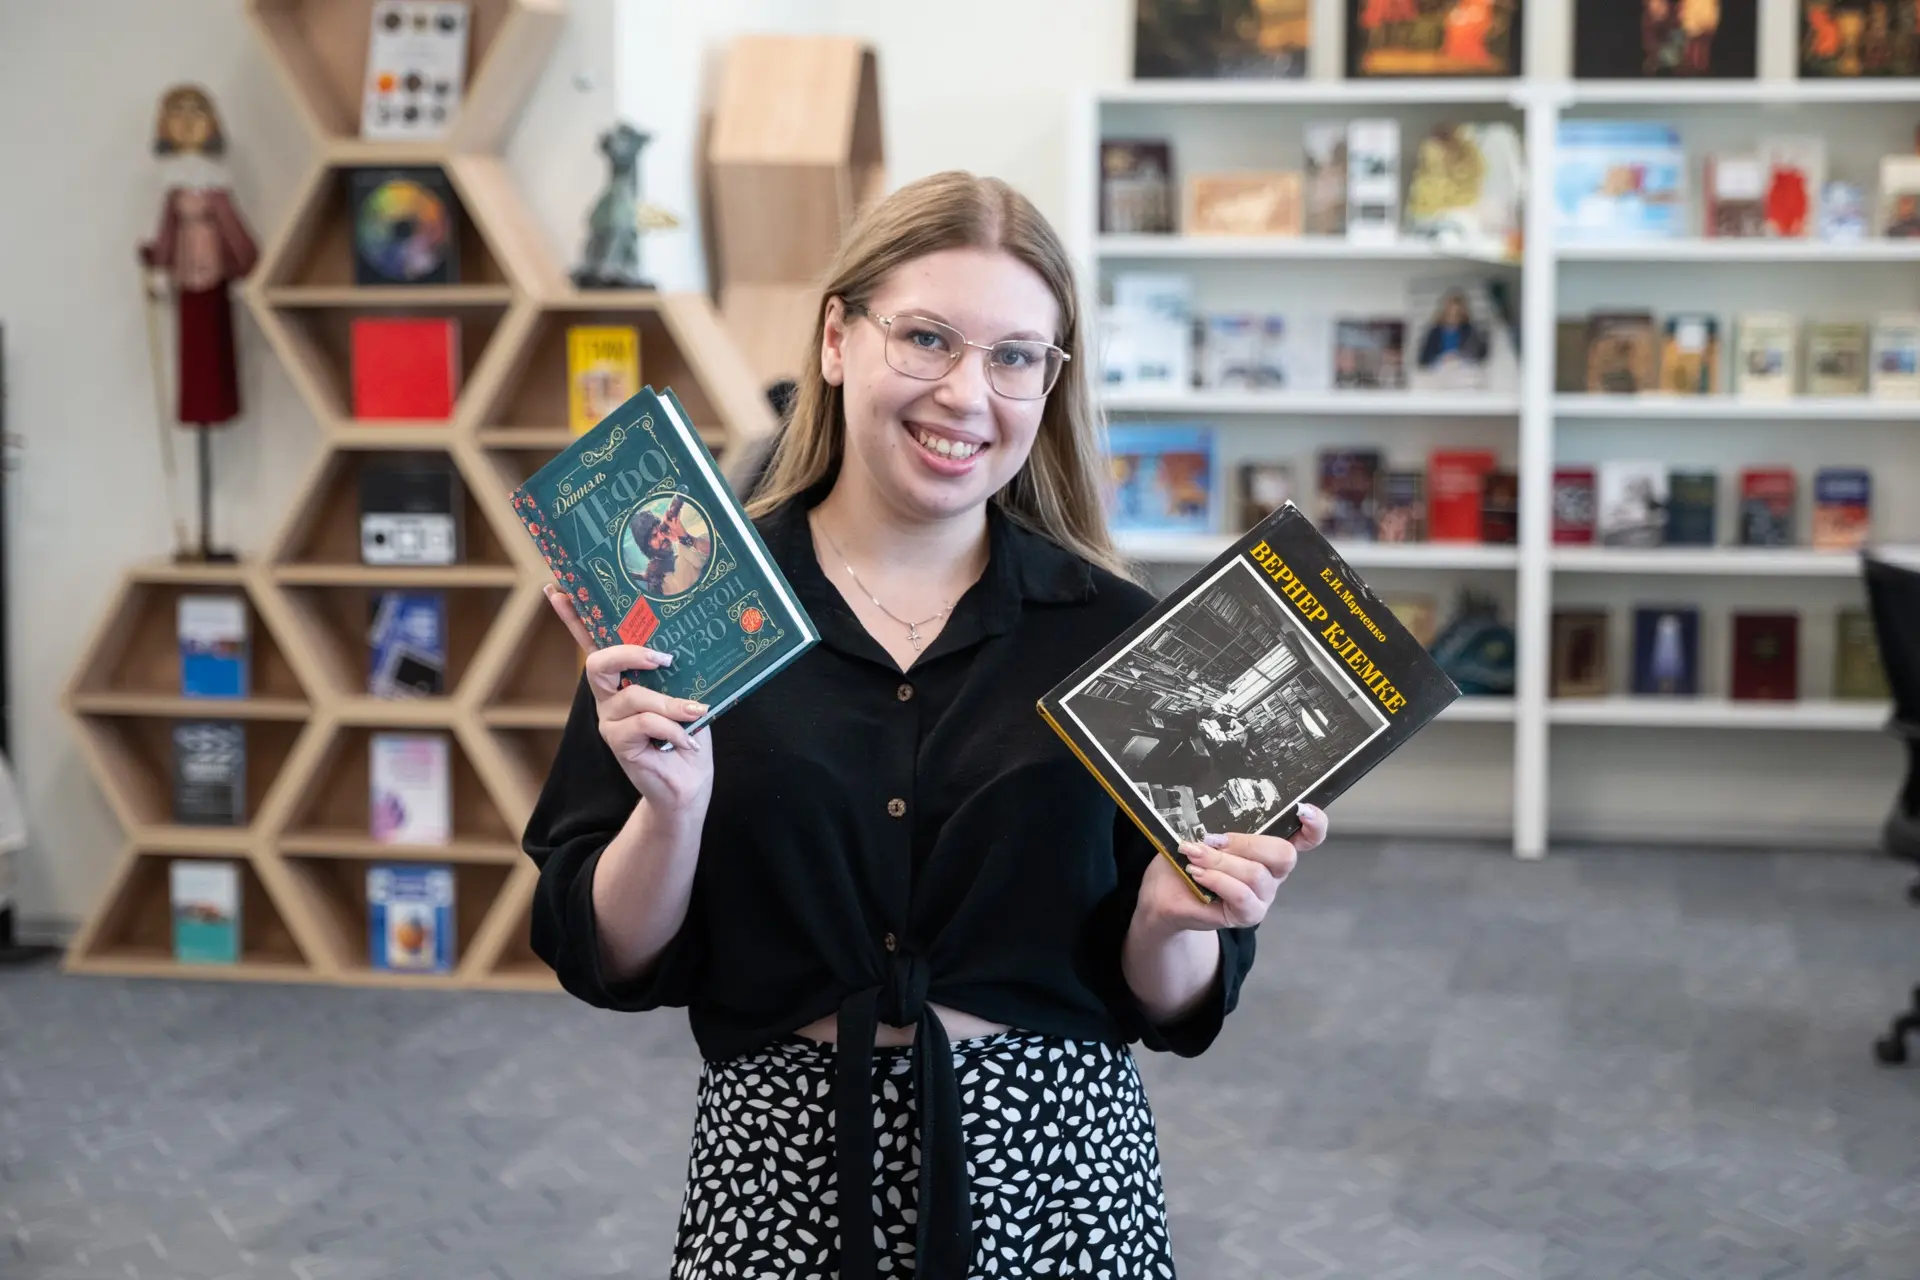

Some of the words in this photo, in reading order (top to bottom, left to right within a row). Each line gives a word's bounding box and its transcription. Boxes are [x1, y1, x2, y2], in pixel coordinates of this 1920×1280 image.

[552, 472, 607, 519] Даниэль
[565, 449, 668, 572] ДЕФО
[646, 575, 746, 652] ОБИНЗОН
[1249, 540, 1329, 622] ВЕРНЕР
[1321, 621, 1407, 714] КЛЕМКЕ
